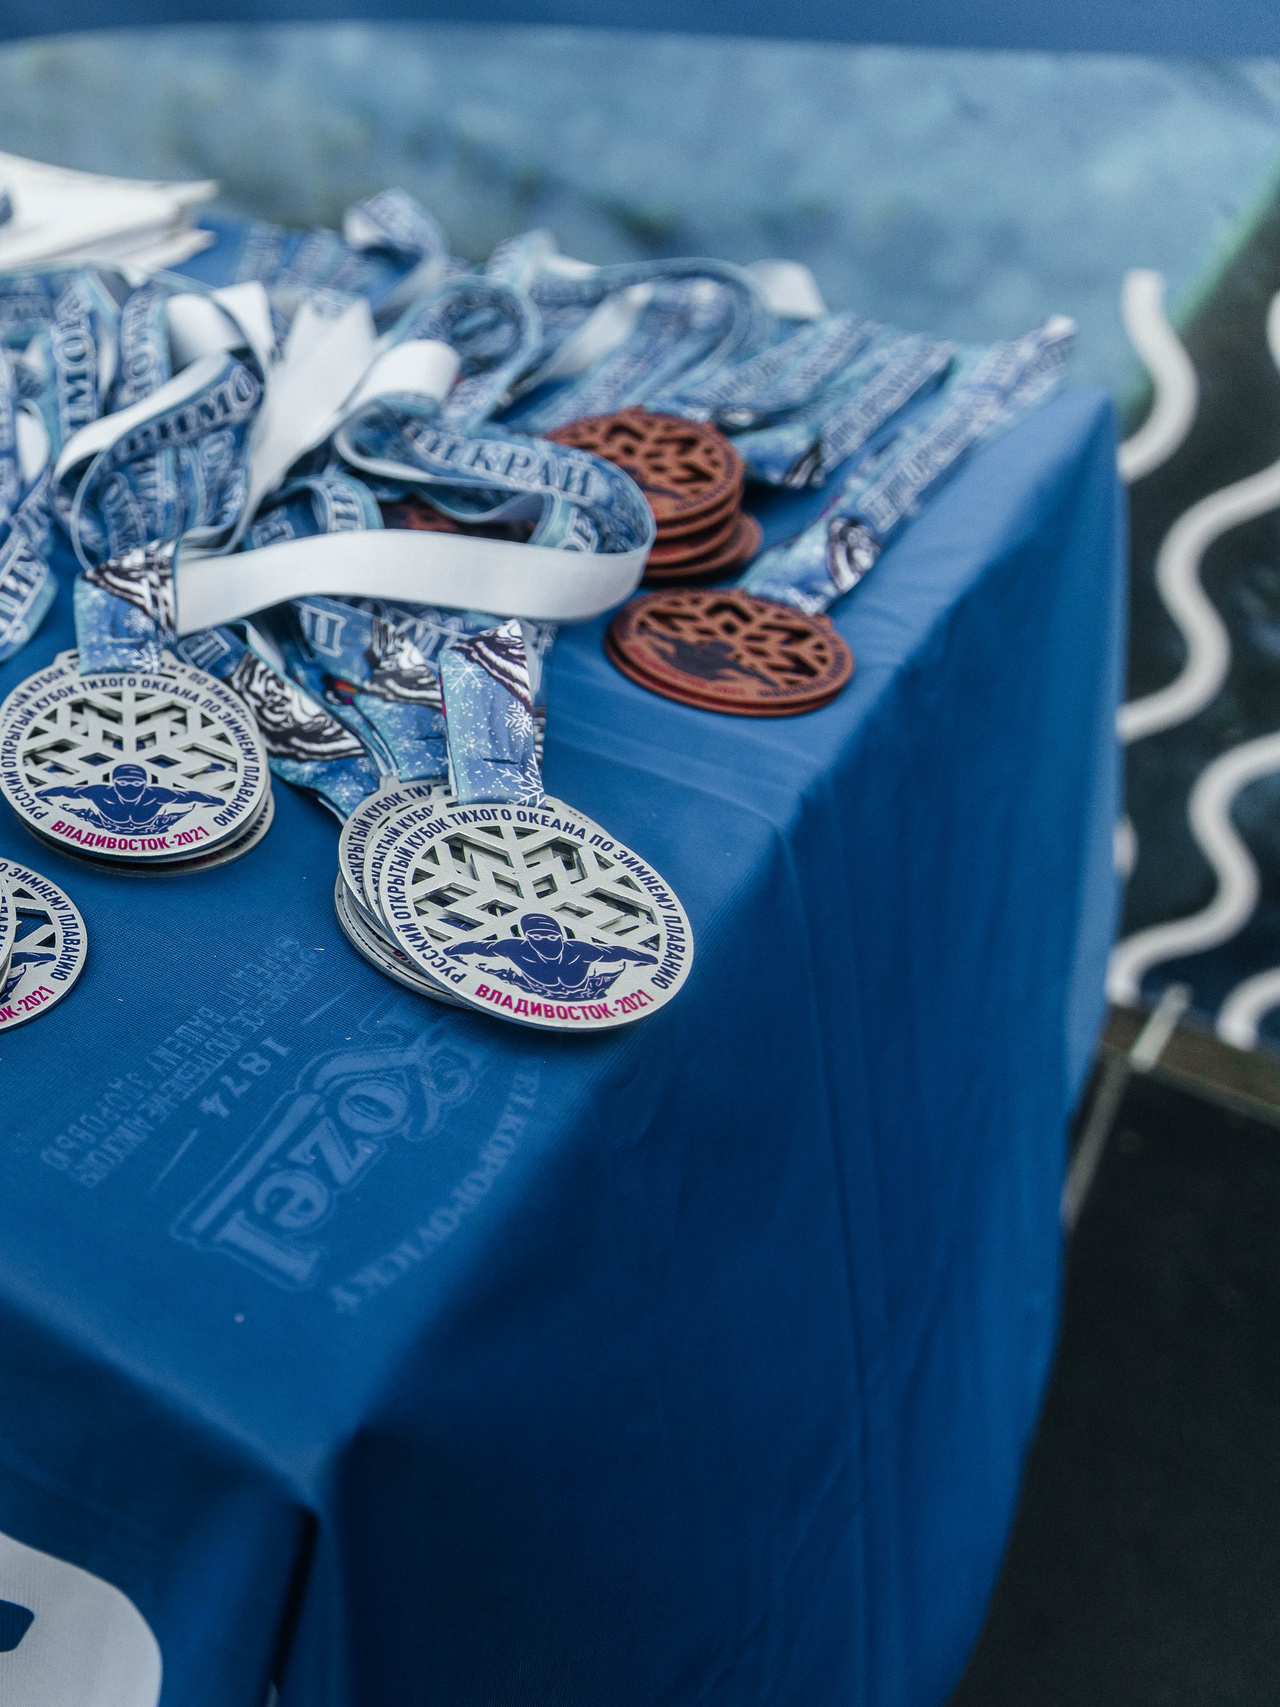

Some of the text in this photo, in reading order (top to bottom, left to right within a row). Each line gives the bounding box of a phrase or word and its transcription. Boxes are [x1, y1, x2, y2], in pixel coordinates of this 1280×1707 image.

[35, 685, 78, 713] КУБОК
[80, 676, 137, 693] ТИХОГО
[141, 677, 201, 703] ОКЕАНА
[202, 698, 221, 714] ПО
[1, 703, 38, 771] ОТКРЫТЫЙ
[218, 710, 260, 766] ЗИМНЕМУ
[0, 773, 48, 820] РУССКИЙ
[212, 764, 261, 827] ПЛАВАНИЮ
[363, 792, 404, 826] КУБОК
[396, 804, 434, 830] КУБО
[50, 820, 210, 851] ВЛАДИВОСТОК-2021
[8, 867, 71, 911] ЗИМНЕМУ
[50, 914, 81, 981] ПЛАВАНИЮ
[387, 808, 686, 991] РУССКИЙ ОТКРЫТЫЙ КУБОК ТИХОГО ОКЕАНА ПО ЗИМНЕМУ ПЛАВАНИЮ
[474, 983, 656, 1022] ВЛАДИВОСТОК-2021
[143, 1002, 224, 1079] ВАШЕМУ
[199, 1035, 293, 1118] 1874
[37, 1065, 153, 1176] ЗДОРОВЬЮ
[182, 1005, 490, 1288] Kozel
